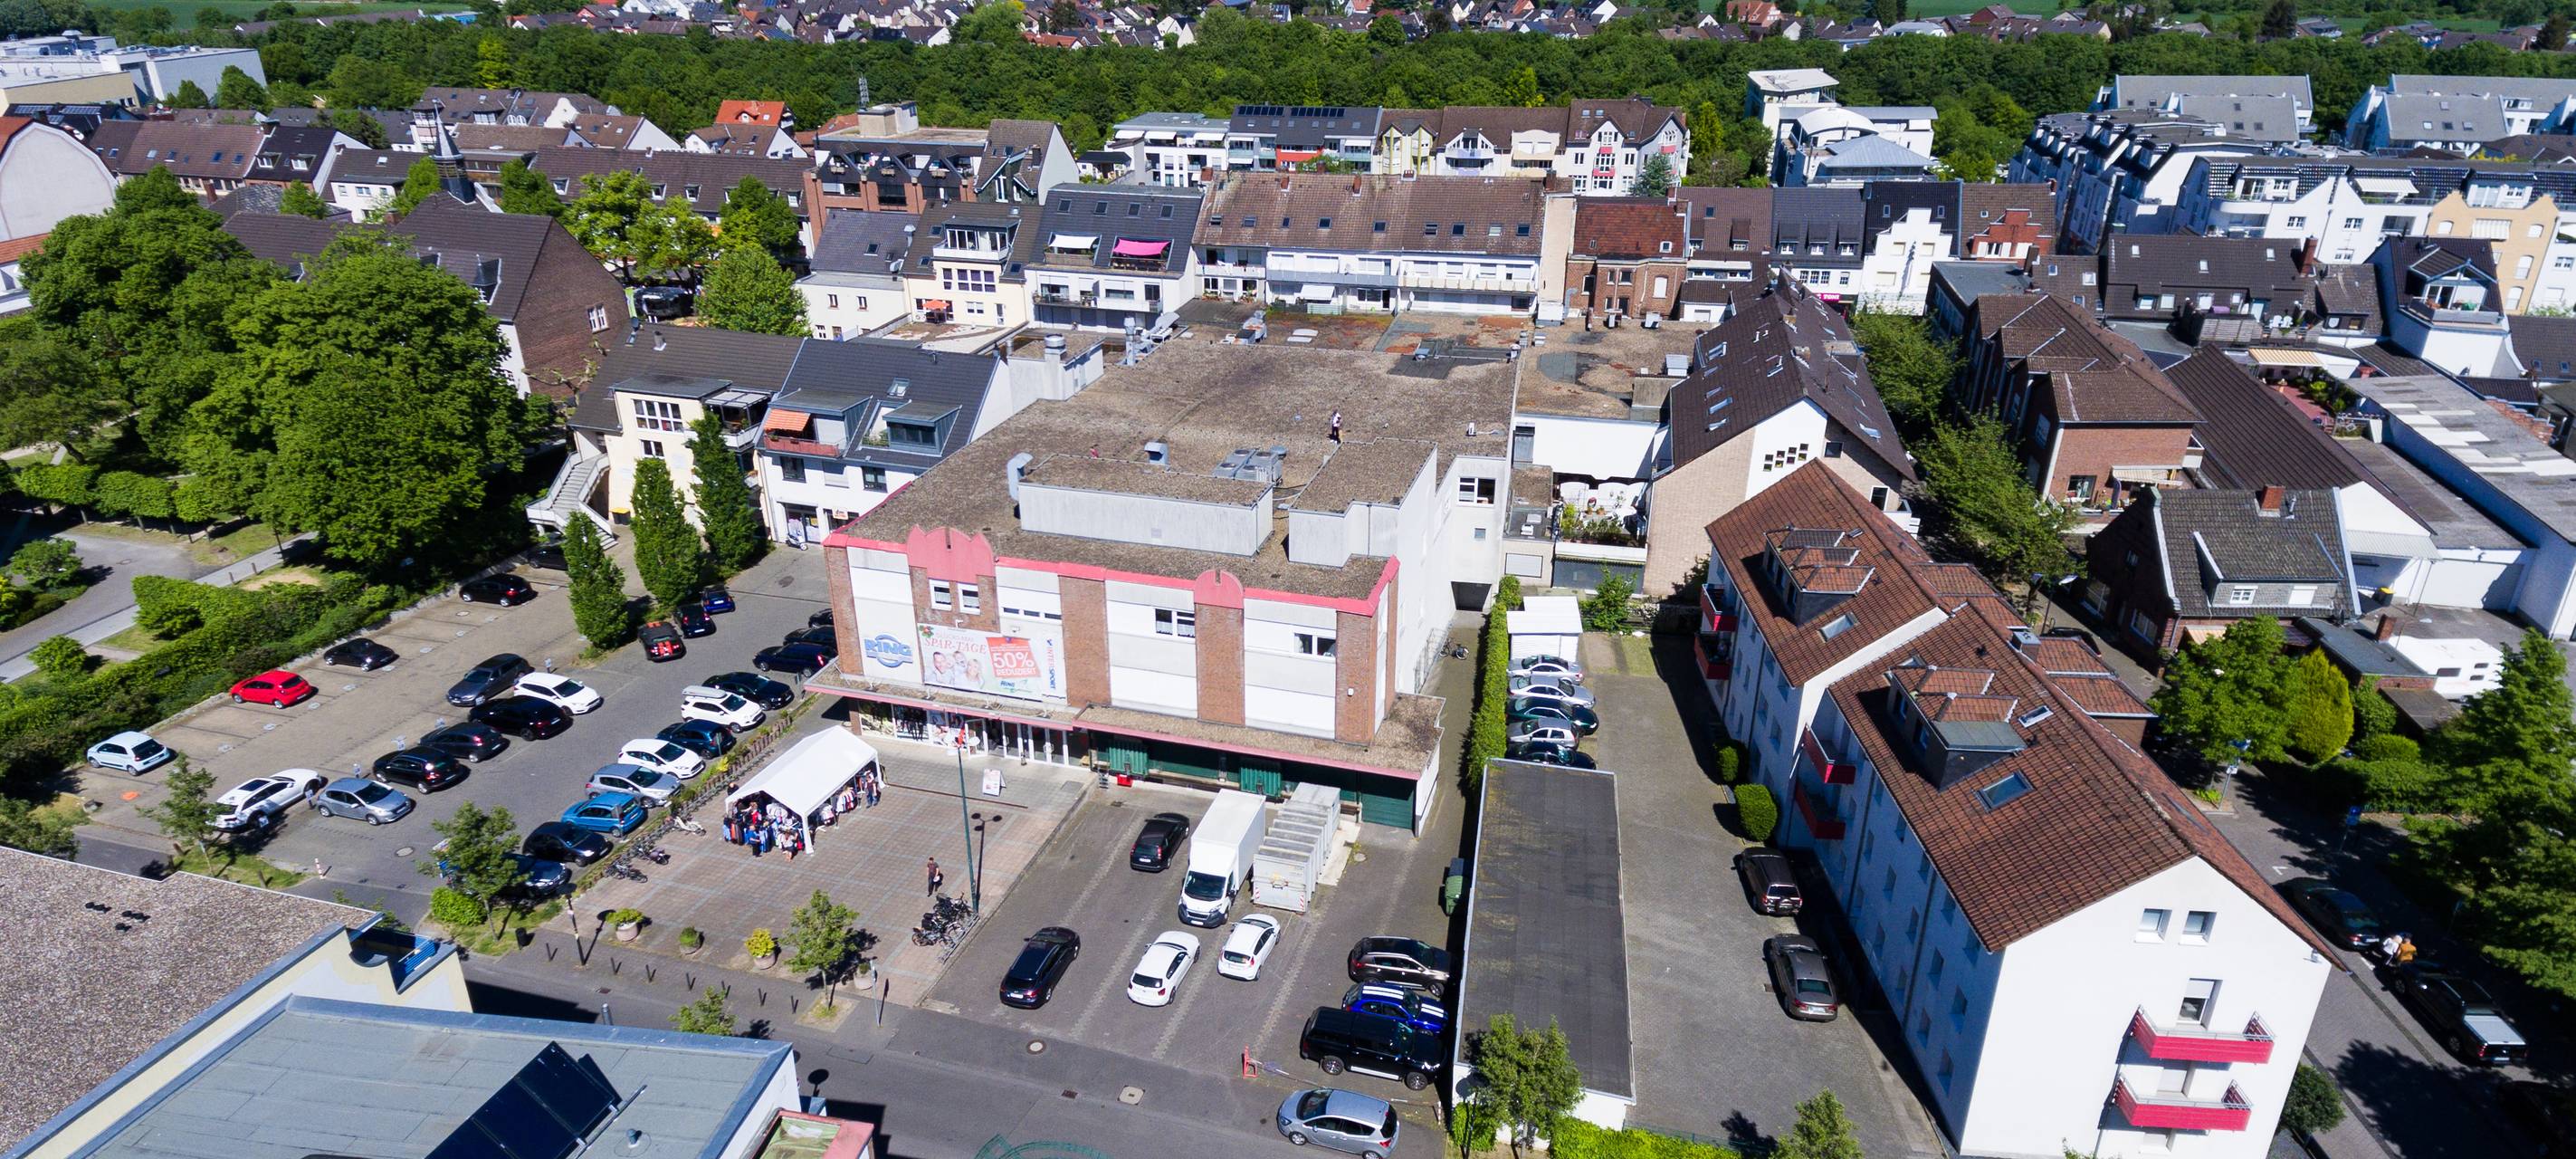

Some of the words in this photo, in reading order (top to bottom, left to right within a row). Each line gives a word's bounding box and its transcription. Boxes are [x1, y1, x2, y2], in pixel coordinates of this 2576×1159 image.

[864, 638, 912, 656] RING
[925, 637, 987, 654] SPAR-TAGE
[992, 652, 1035, 668] 50%
[1046, 647, 1056, 689] INTERSPORT
